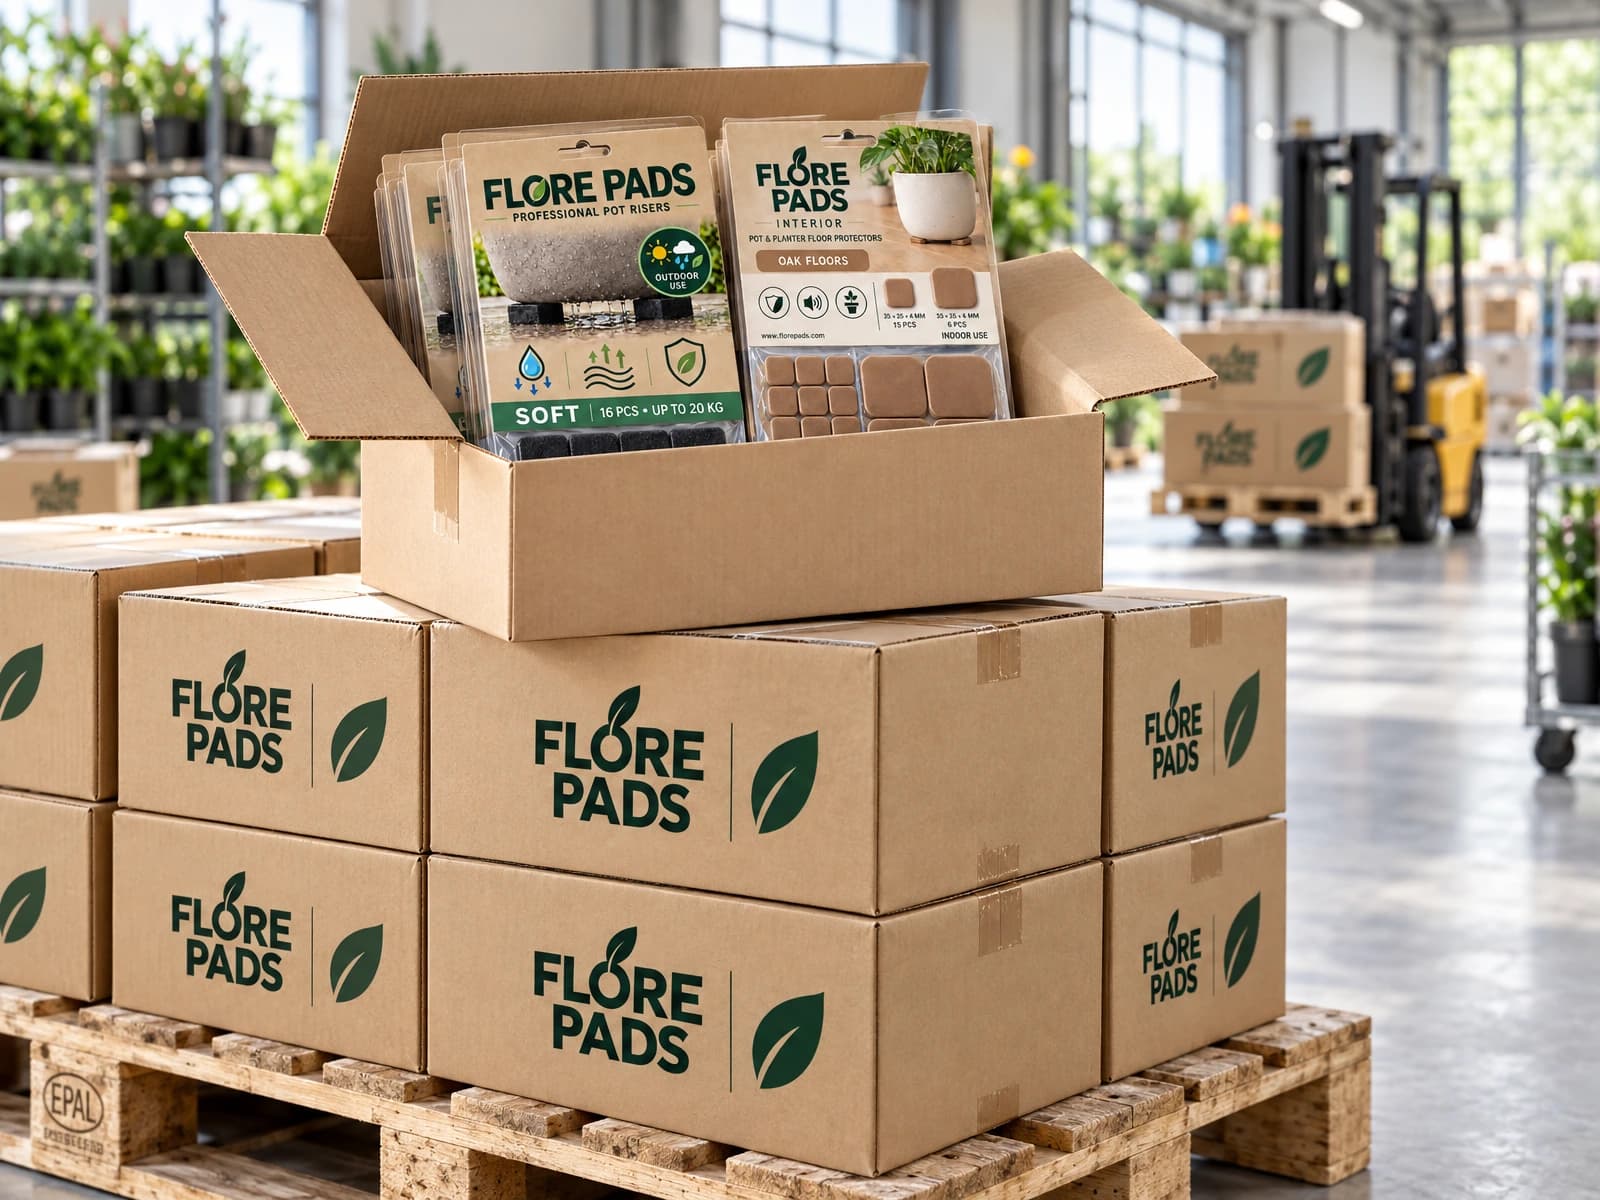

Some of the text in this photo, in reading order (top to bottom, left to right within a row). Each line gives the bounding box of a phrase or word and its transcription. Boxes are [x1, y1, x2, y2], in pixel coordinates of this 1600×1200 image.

[483, 163, 696, 210] FLORE PADS
[755, 162, 850, 187] FLORE
[512, 202, 671, 222] PROFESSIONAL POT RISERS
[771, 188, 849, 212] PADS
[749, 233, 883, 243] POT & PLANTER FLOOR PROTECTORS
[776, 218, 843, 228] INTERIOR
[655, 271, 700, 281] OUTDOOR
[778, 255, 849, 266] OAK FLOORS
[669, 281, 688, 290] USE
[760, 331, 826, 341] www.florepads.com
[941, 331, 988, 340] INDOOR USE
[515, 404, 580, 425] SOFT
[600, 407, 614, 419] 16
[616, 405, 640, 418] PCS
[651, 404, 669, 416] UP
[670, 403, 687, 415] TO
[689, 402, 705, 415] 20
[707, 401, 724, 414] KG
[172, 679, 292, 731] FLORE
[1145, 703, 1203, 746] FLORE
[187, 722, 283, 774] PADS
[535, 719, 705, 781] FLORE
[1152, 740, 1199, 780] PADS
[553, 771, 691, 833] PADS
[171, 895, 292, 951] FLORE
[186, 938, 283, 992] PADS
[1143, 928, 1202, 974] FLORE
[533, 951, 703, 1025] FLORE
[1151, 963, 1199, 1005] PADS
[552, 1004, 689, 1075] PADS
[50, 1082, 97, 1124] EPAL
